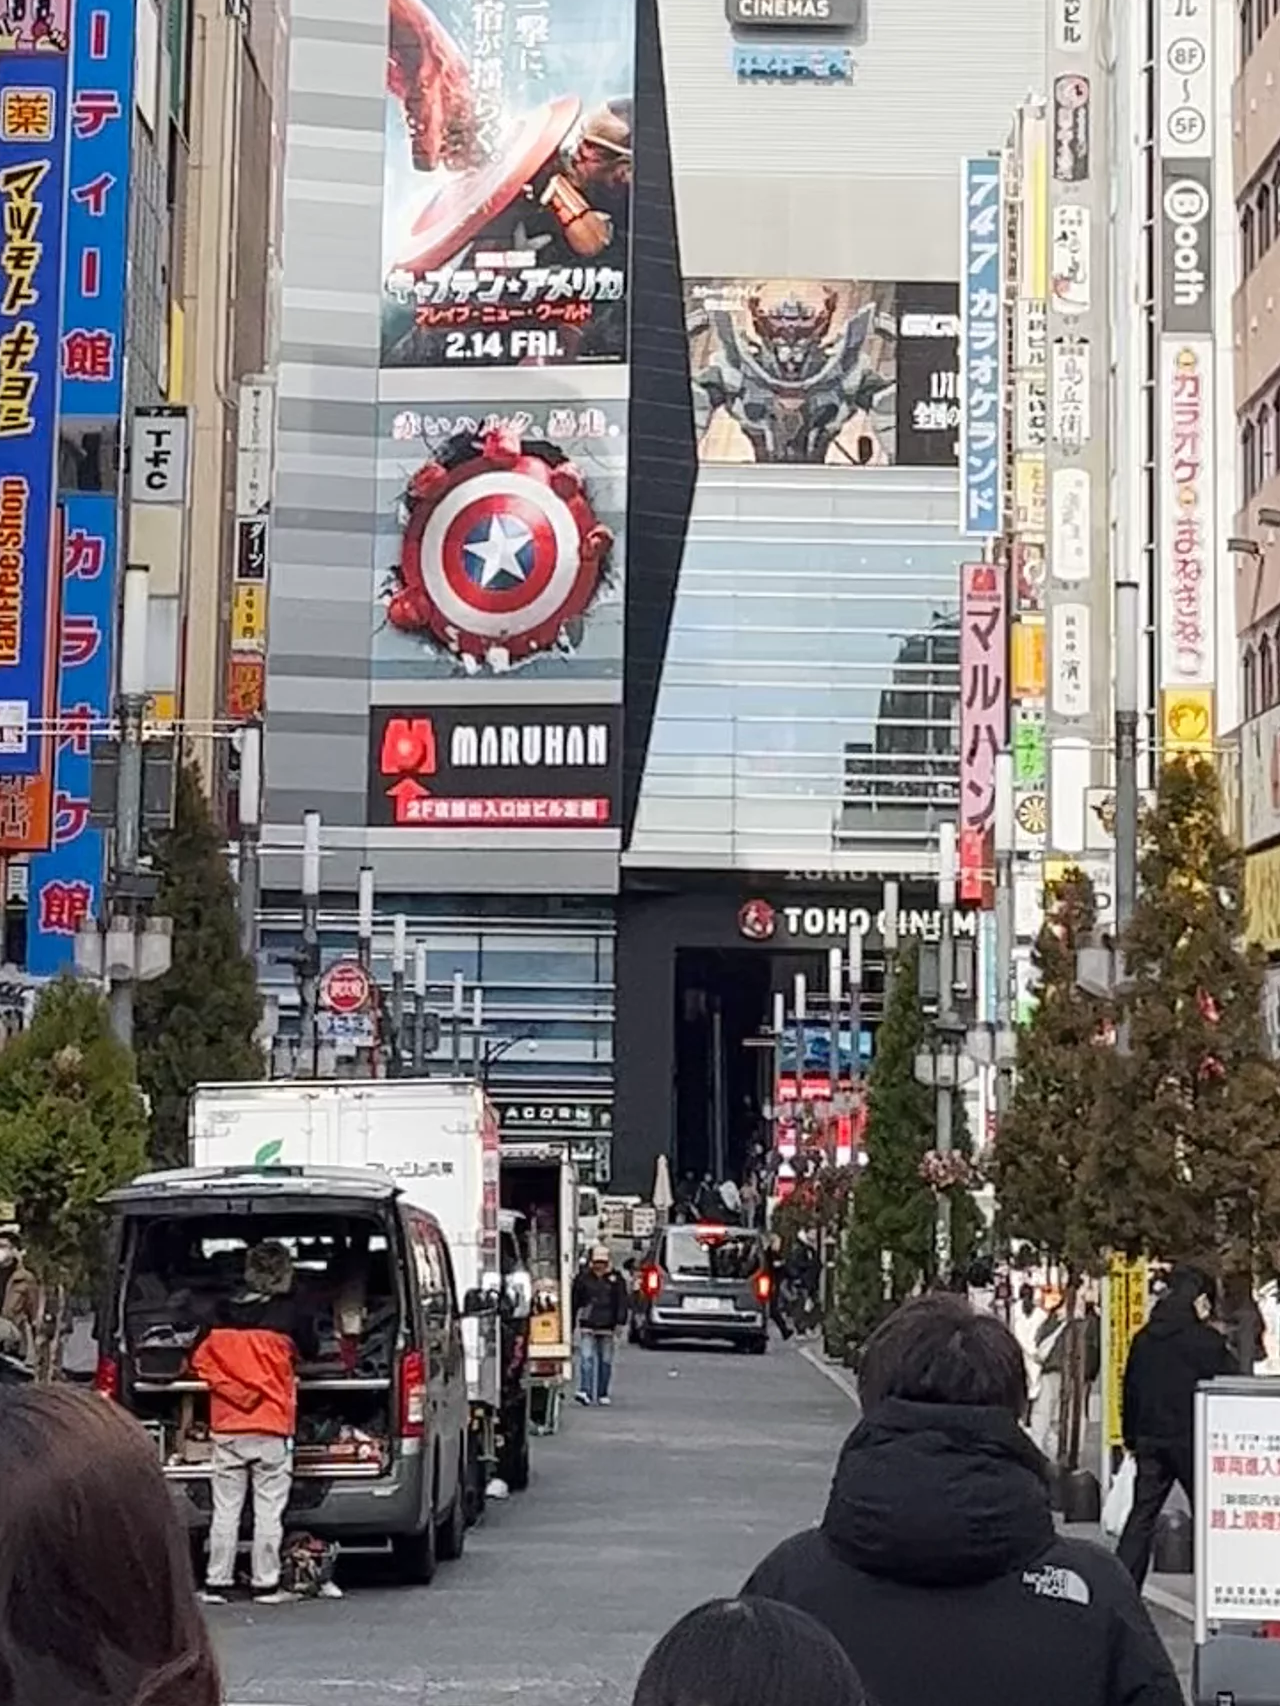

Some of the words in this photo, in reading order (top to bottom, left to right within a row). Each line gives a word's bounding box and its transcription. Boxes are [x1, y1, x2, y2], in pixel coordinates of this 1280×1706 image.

[738, 0, 829, 17] CINEMAS
[3, 91, 52, 137] 薬
[1162, 179, 1210, 305] Booth
[445, 330, 504, 358] 2.14
[509, 329, 565, 358] FRI.
[965, 606, 1002, 826] マルハン
[450, 724, 608, 767] MARUHAN
[783, 908, 870, 936] TOHO
[503, 1106, 591, 1120] ACORN
